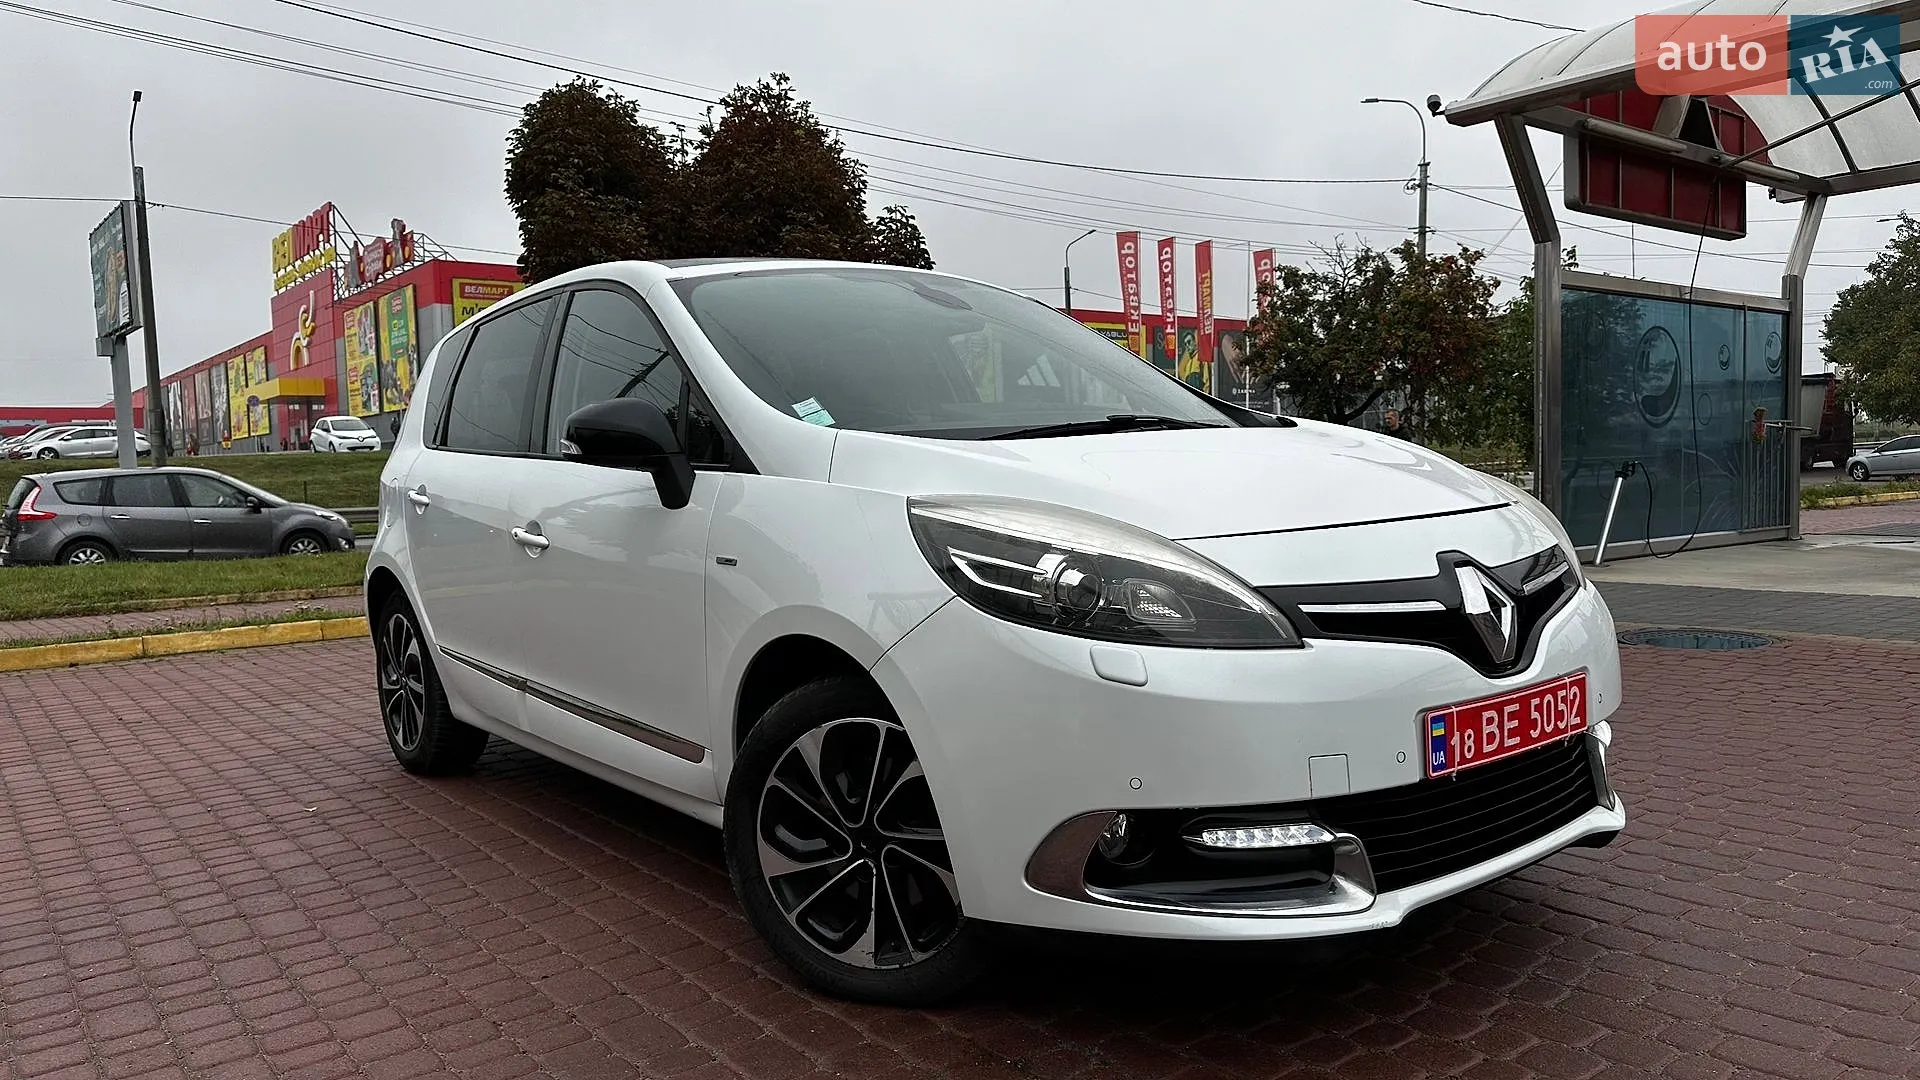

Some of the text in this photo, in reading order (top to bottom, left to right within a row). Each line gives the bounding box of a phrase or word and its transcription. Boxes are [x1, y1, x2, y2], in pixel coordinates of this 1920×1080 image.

[464, 285, 509, 295] ВЕЛМАРТ
[1451, 685, 1581, 763] 18 BE 5052
[1433, 752, 1446, 766] UA
